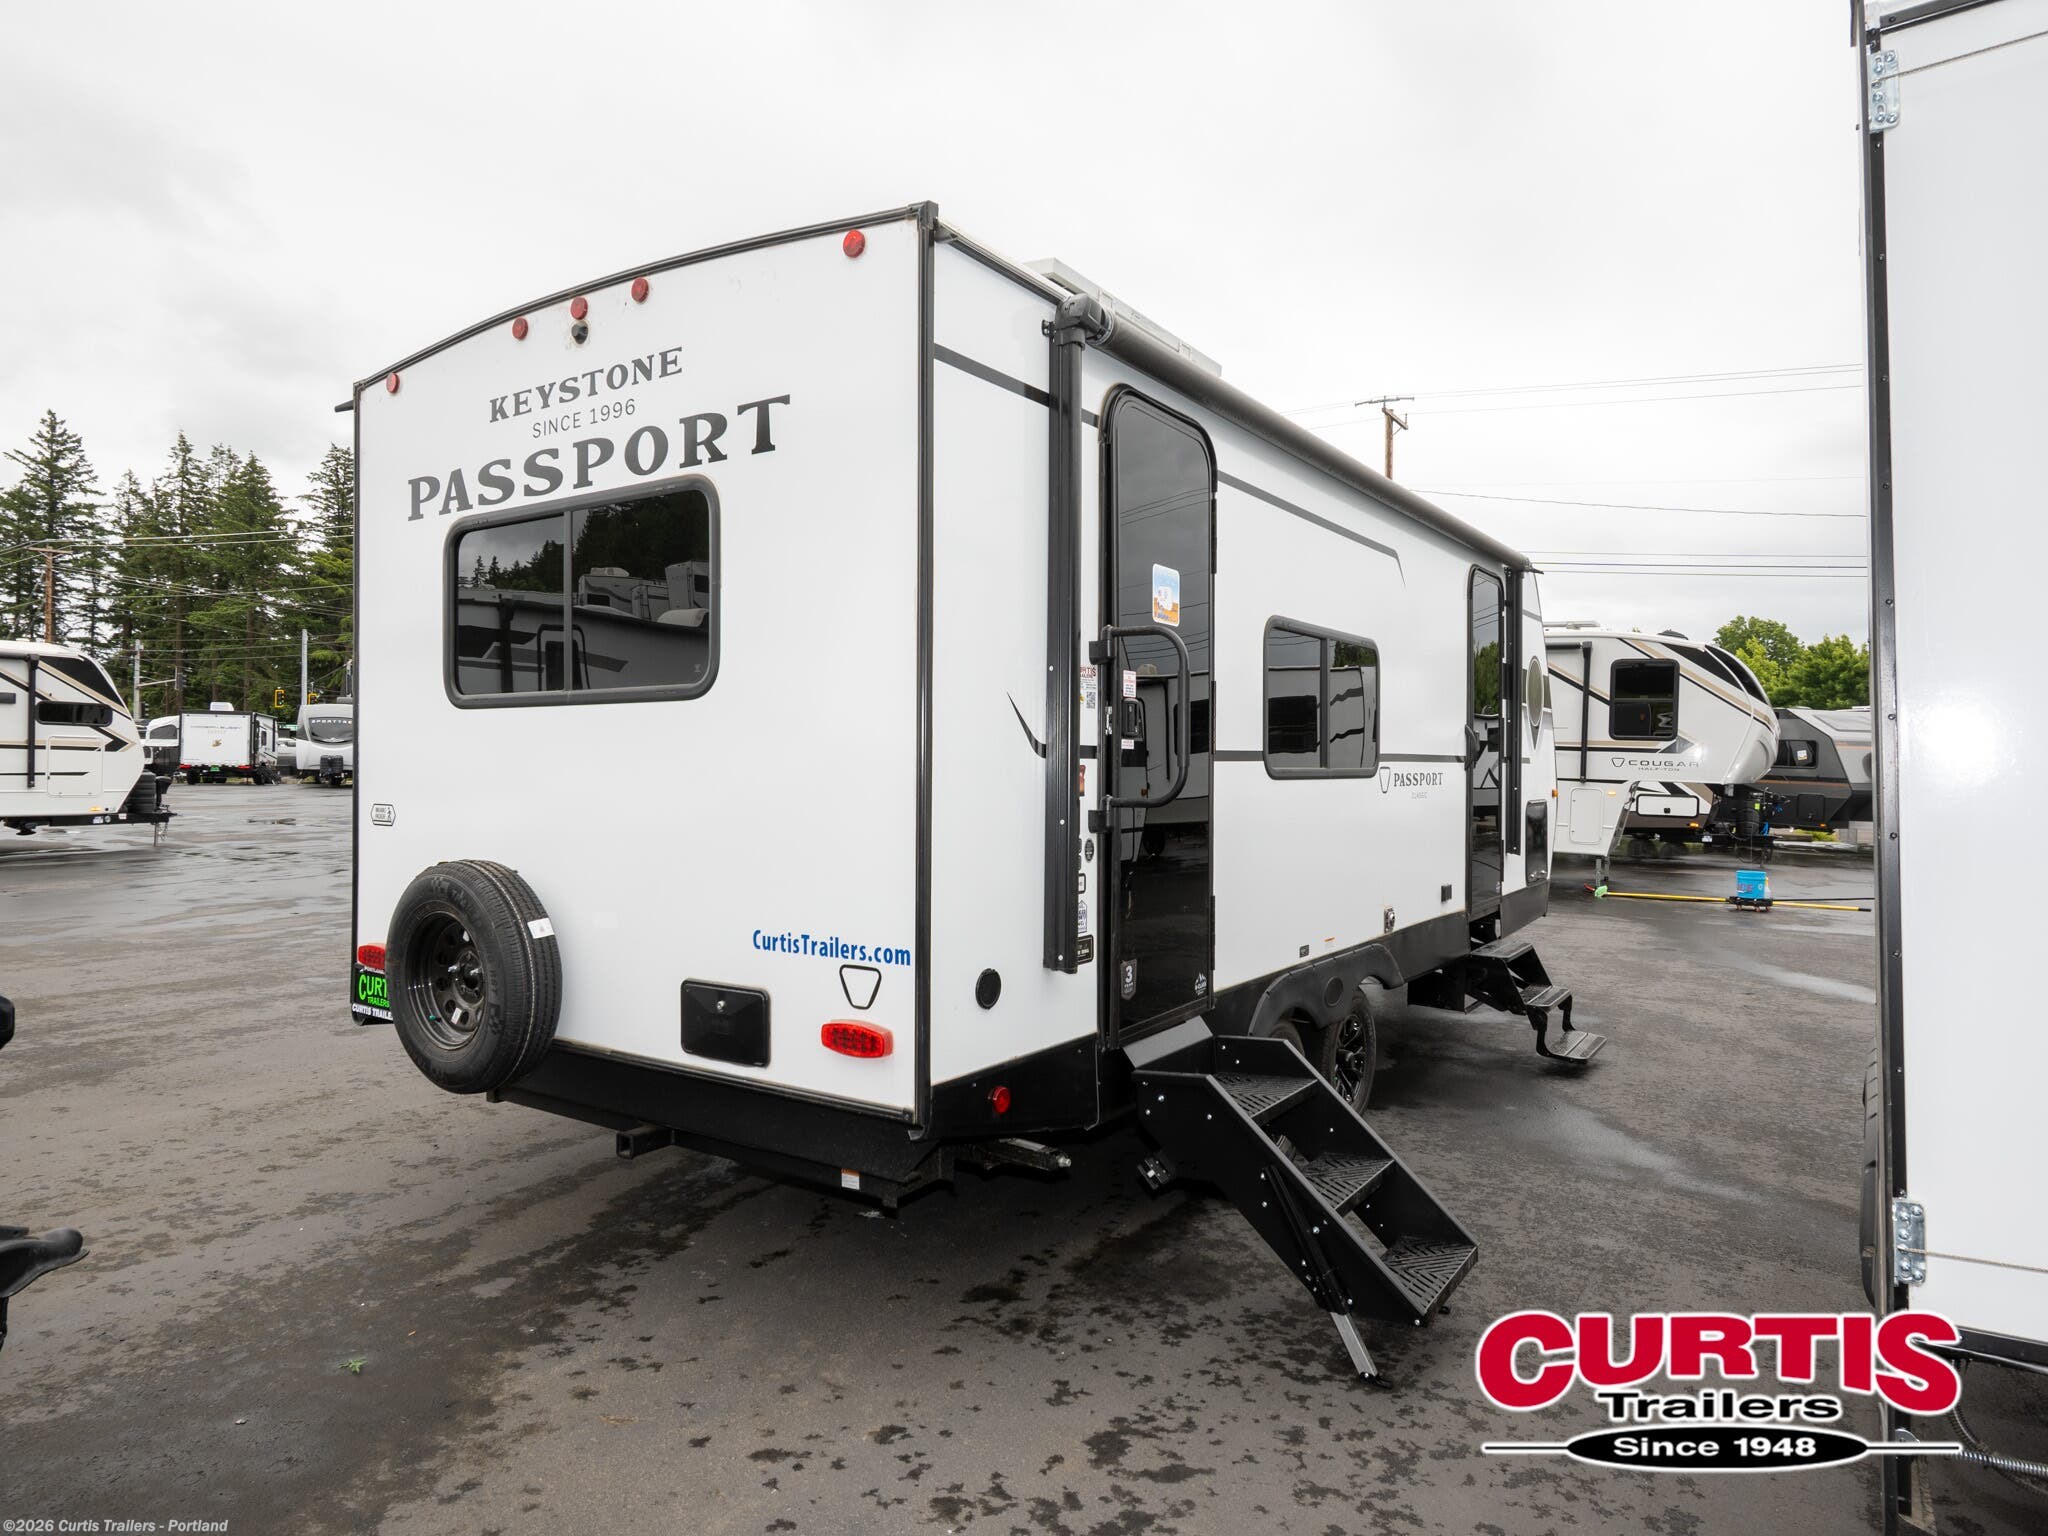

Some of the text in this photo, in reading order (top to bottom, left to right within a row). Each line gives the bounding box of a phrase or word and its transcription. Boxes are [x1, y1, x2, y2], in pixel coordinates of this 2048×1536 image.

[489, 346, 683, 424] KEYSTONE
[532, 398, 637, 439] SINCE 1996
[407, 394, 791, 521] PASSPORT
[1393, 772, 1444, 787] PASSPORT
[1628, 759, 1700, 768] COUGAR
[752, 929, 911, 966] CurtisTrailers.com
[358, 974, 388, 1001] CURT
[1125, 965, 1133, 983] 3
